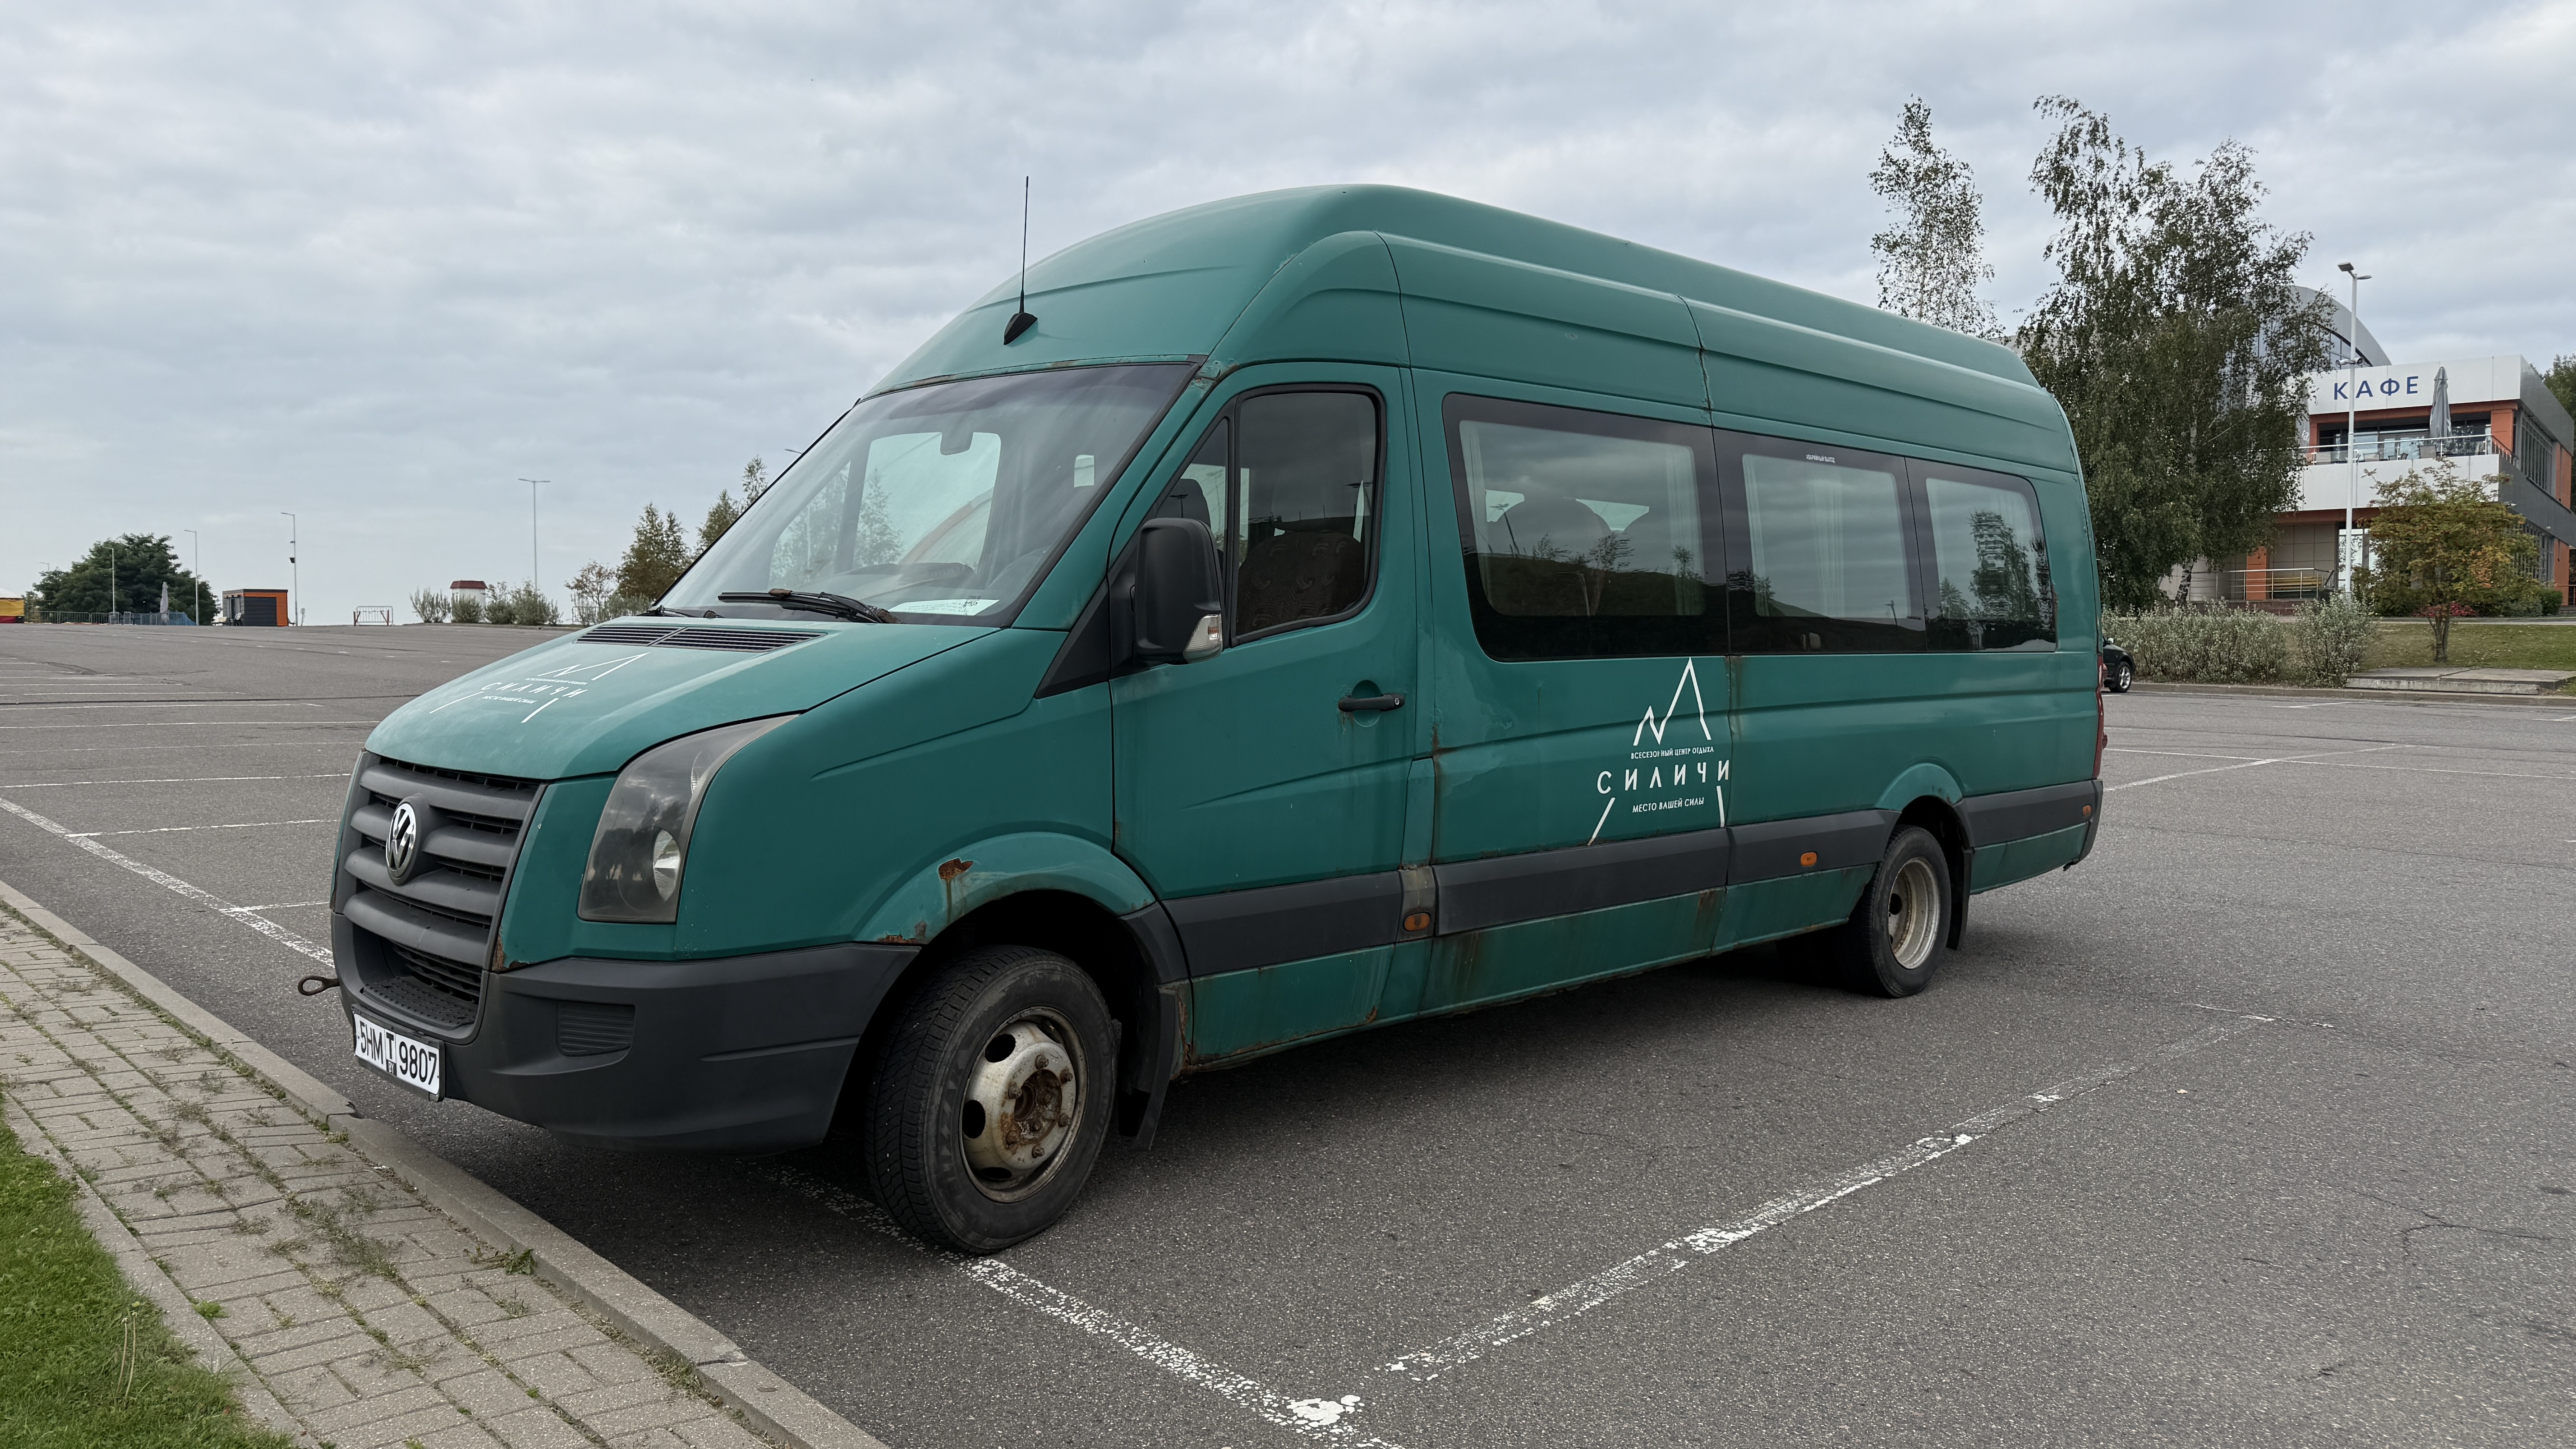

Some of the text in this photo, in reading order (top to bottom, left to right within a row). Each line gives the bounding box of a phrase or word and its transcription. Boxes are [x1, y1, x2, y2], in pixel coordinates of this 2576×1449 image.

[2334, 376, 2419, 400] КАФЕ
[481, 682, 588, 698] СИЛИЧИ
[1674, 747, 1691, 756] ЦЕНТР
[1692, 746, 1714, 754] ОТДЫХА
[1597, 759, 1729, 794] СИЛИЧИ
[1632, 797, 1704, 813] МЕСТО ВАШЕЙ СИЛЫ
